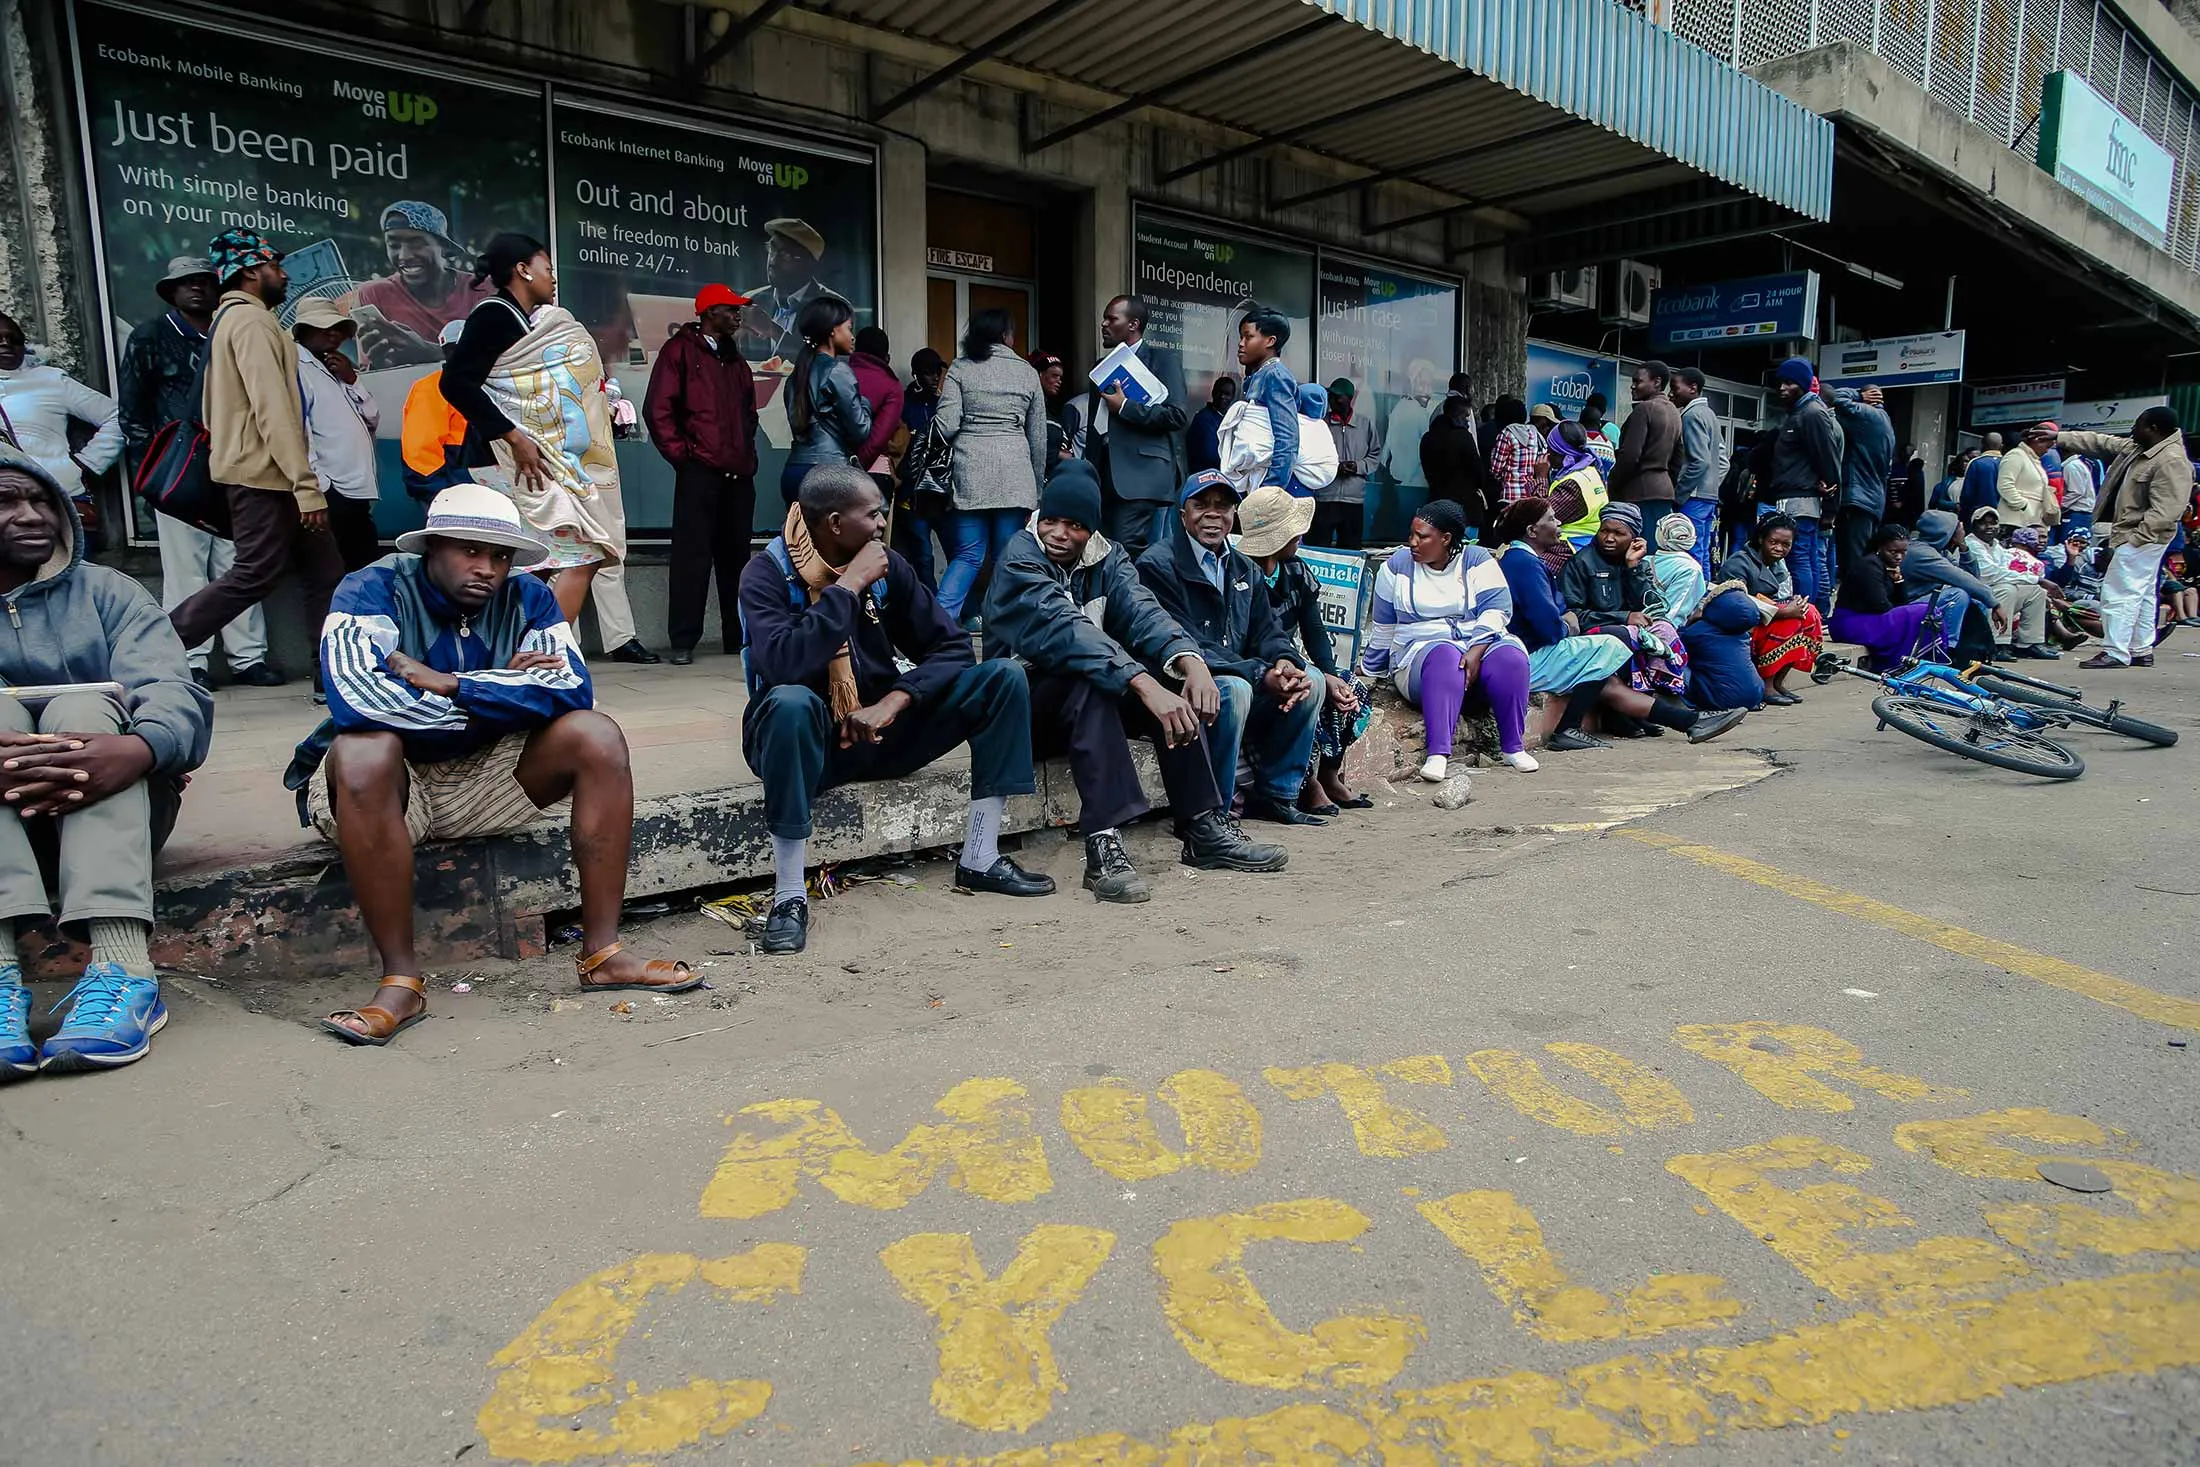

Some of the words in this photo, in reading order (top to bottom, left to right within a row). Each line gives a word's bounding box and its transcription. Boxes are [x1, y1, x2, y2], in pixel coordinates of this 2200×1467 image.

[98, 43, 172, 73] Ecobank
[177, 58, 233, 84] Mobile
[239, 71, 303, 98] Banking
[333, 79, 386, 105] Move
[389, 91, 438, 126] UP
[362, 102, 387, 119] on
[112, 99, 196, 148] Just
[209, 111, 315, 167] been
[329, 142, 408, 180] paid
[560, 130, 616, 152] Ecobank
[619, 140, 671, 161] Internet
[674, 150, 725, 173] Banking
[738, 156, 773, 175] Move
[775, 164, 809, 190] UP
[757, 172, 774, 186] on
[118, 163, 175, 190] With
[183, 173, 258, 204] simple
[265, 183, 349, 217] banking
[576, 179, 620, 209] Out
[629, 190, 674, 217] and
[684, 195, 749, 228] about
[122, 197, 153, 217] on
[163, 202, 212, 225] your
[220, 205, 315, 236] mobile...
[577, 221, 608, 240] The
[613, 226, 680, 250] freedom
[684, 235, 699, 252] to
[704, 237, 740, 258] bank
[1163, 237, 1188, 251] Account
[1193, 239, 1215, 252] Move
[578, 246, 629, 267] online
[635, 251, 689, 275] 24/7...
[930, 248, 952, 265] FIRE
[955, 252, 990, 270] ESCAPE
[1204, 250, 1215, 261] on
[1142, 259, 1253, 298] Independence!
[1364, 276, 1381, 288] Move
[1765, 290, 1777, 298] 24
[1778, 287, 1803, 297] HOUR
[1142, 294, 1159, 304] With
[1160, 298, 1169, 306] an
[1320, 295, 1349, 323] Just
[1354, 300, 1367, 323] in
[1371, 309, 1402, 331] case
[1655, 286, 1721, 315] Ecobank
[1764, 299, 1783, 308] ATM
[1321, 329, 1341, 343] With
[1550, 372, 1595, 401] Ecobank
[1310, 564, 1359, 583] onicle
[700, 1019, 1970, 1219] MOTOR
[477, 1107, 2200, 1463] CYCLES
